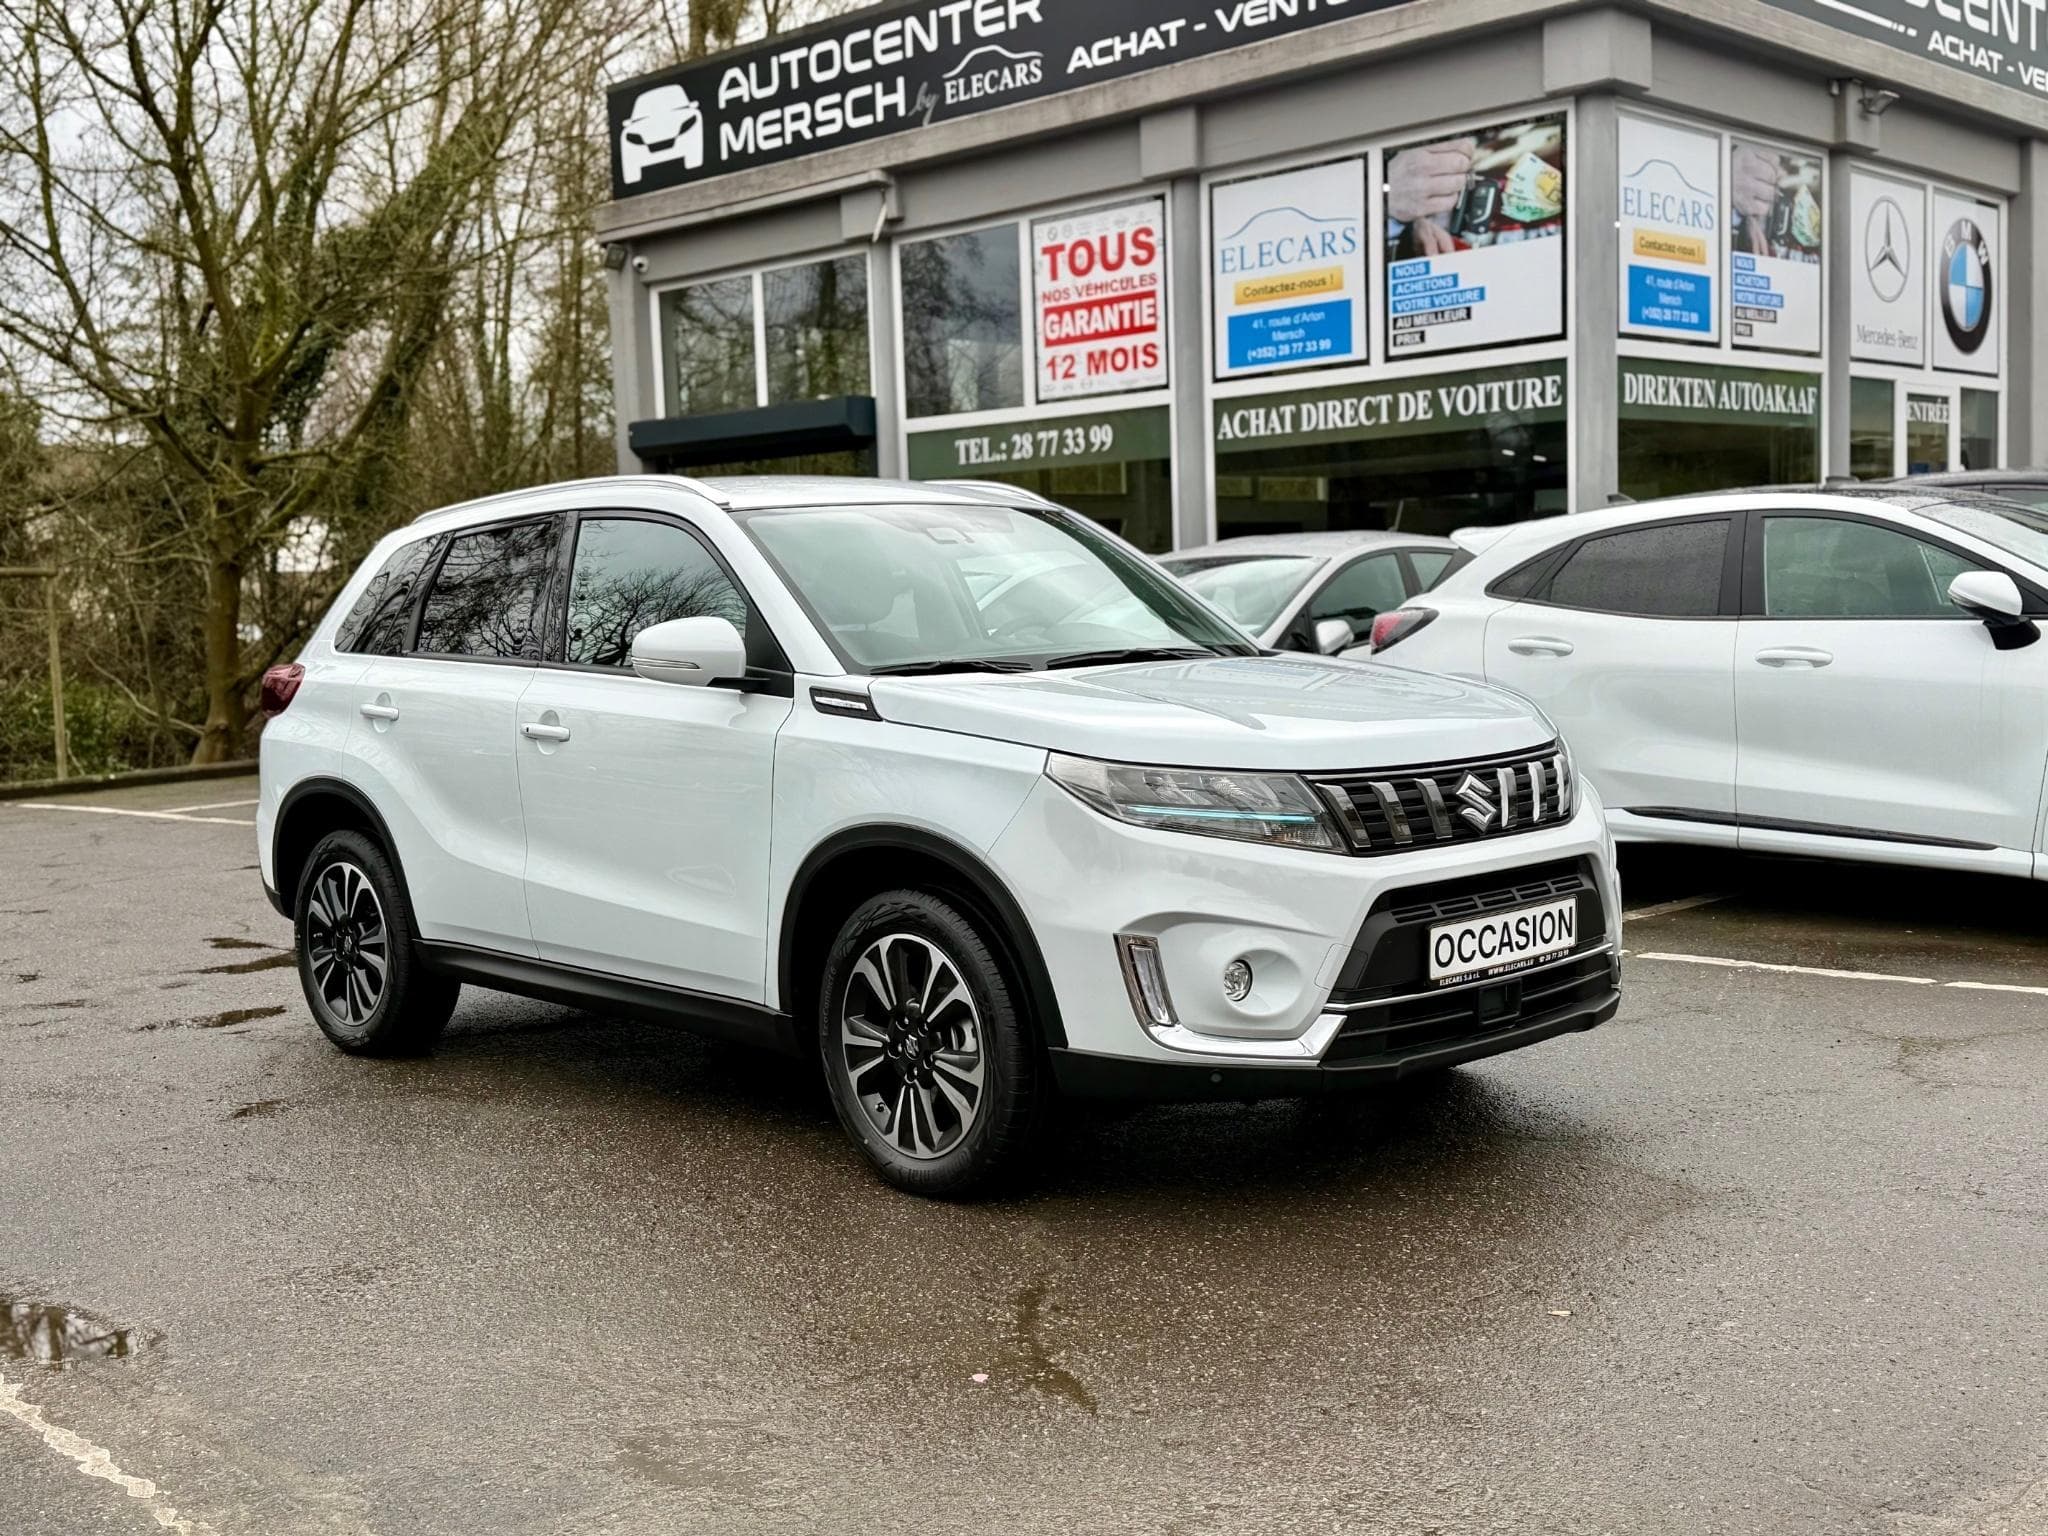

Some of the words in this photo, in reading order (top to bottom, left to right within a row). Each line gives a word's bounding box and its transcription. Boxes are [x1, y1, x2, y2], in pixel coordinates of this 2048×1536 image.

[718, 0, 1043, 109] AUTOCENTER
[1066, 19, 1186, 73] ACHAT
[1214, 0, 1349, 32] VEN
[1927, 30, 2003, 74] ACHAT
[2018, 61, 2048, 92] VE
[908, 81, 940, 129] by
[944, 60, 1042, 104] ELECARS
[720, 76, 905, 160] MERSCH
[1623, 183, 1714, 231] ELECARS
[1042, 226, 1156, 281] TOUS
[1220, 226, 1358, 275] ELECARS
[1945, 220, 1988, 265] BMW
[1243, 276, 1327, 298] Contactez-nous
[1395, 262, 1426, 278] NOUS
[1395, 276, 1455, 295] ACHETONS
[1042, 287, 1070, 303] NOS
[1395, 297, 1432, 312] VOTRE
[1432, 289, 1481, 307] VOITURE
[1044, 298, 1156, 342] GARANTIE
[1271, 328, 1306, 342] Mersch
[1396, 317, 1412, 329] AU
[1413, 308, 1467, 326] MEILLEUR
[1396, 332, 1421, 345] PRIX
[1857, 323, 1918, 350] Mercedes-Benz
[1046, 354, 1076, 381] 12
[1087, 343, 1158, 376] MOIS
[1291, 342, 1304, 354] 77
[1305, 340, 1317, 352] 33
[1217, 404, 1296, 441] ACHAT
[1300, 394, 1393, 433] DIRECT
[1397, 388, 1434, 423] DE
[1438, 375, 1562, 417] VOITURE
[1624, 372, 1716, 409] DIREKTEN
[1718, 381, 1817, 415] AUTOAKAAF
[1906, 396, 1950, 424] ENTRÉE
[1012, 433, 1033, 460] 28
[1037, 430, 1058, 458] 77
[1063, 427, 1085, 455] 33
[1089, 424, 1113, 452] 99
[1434, 905, 1573, 969] OCCASION
